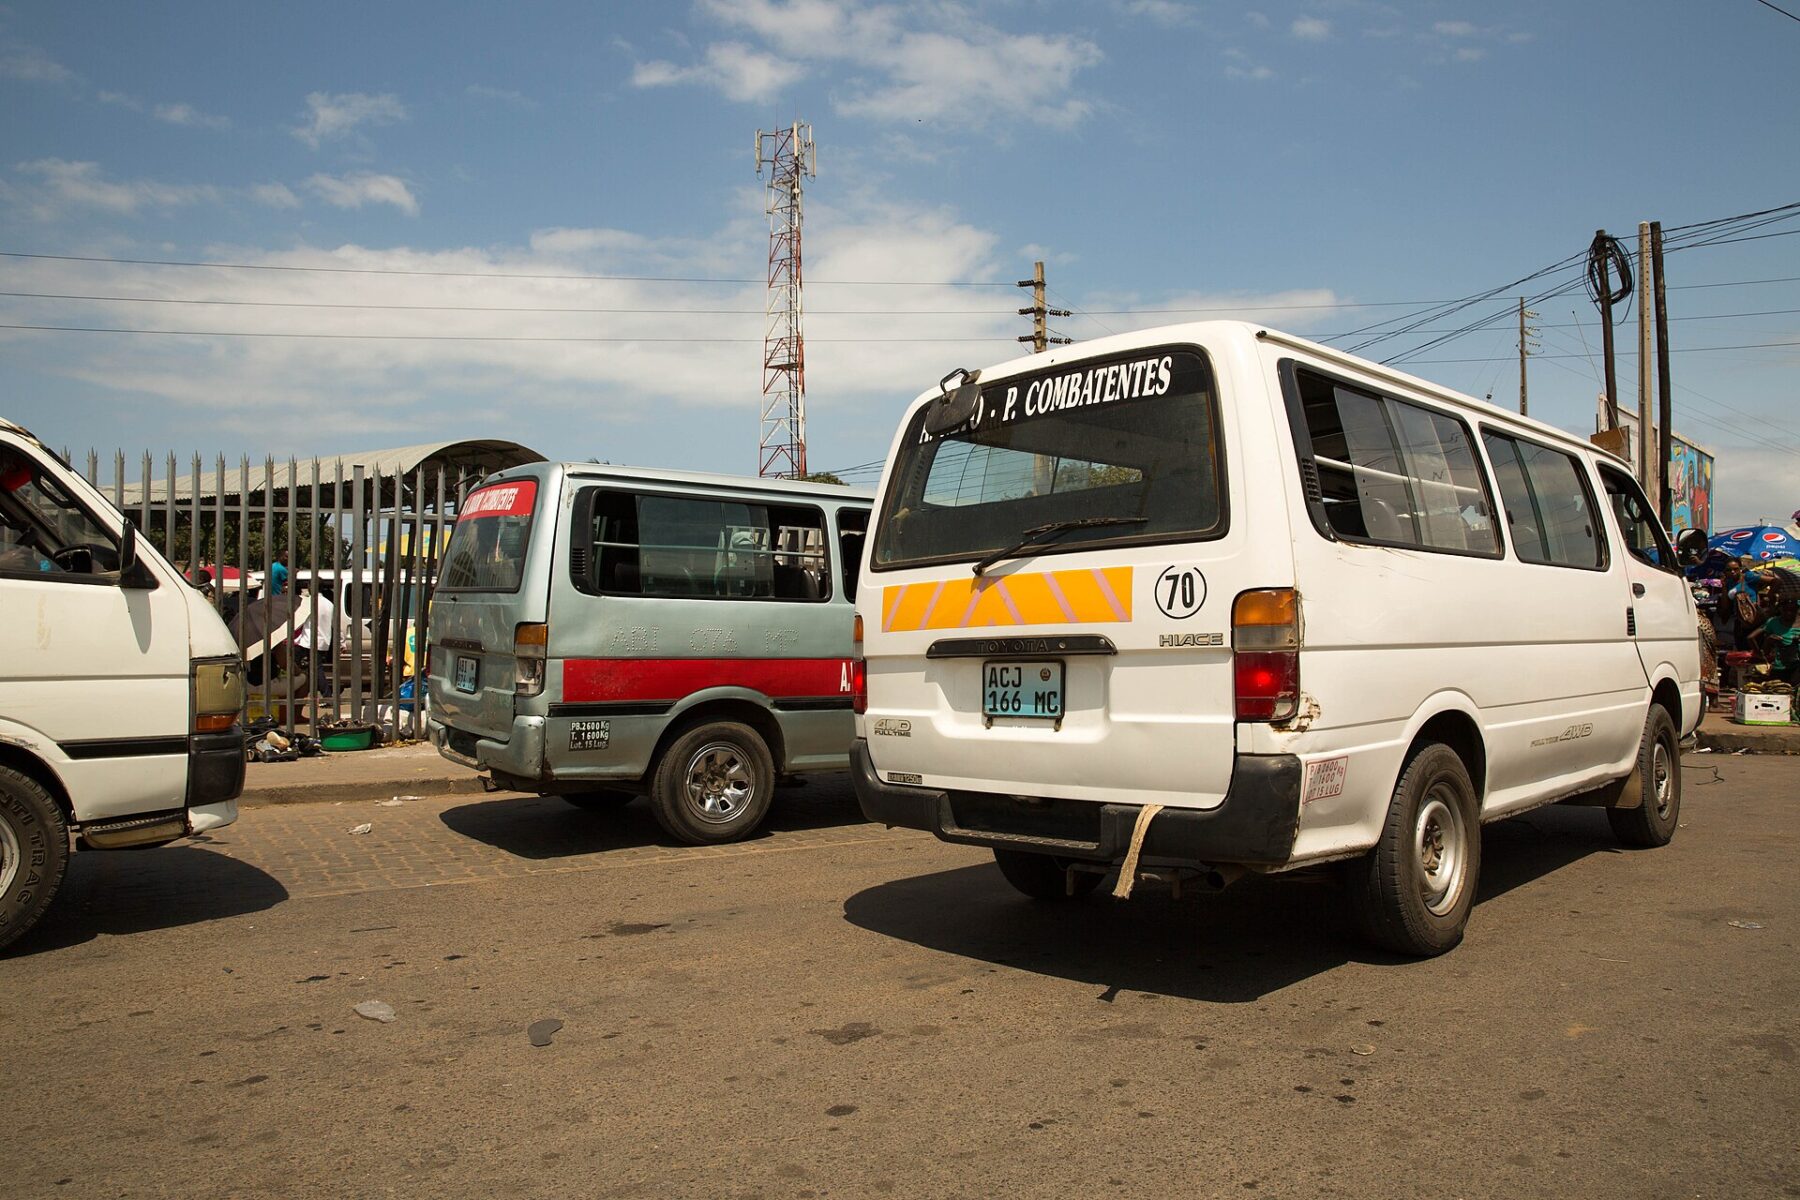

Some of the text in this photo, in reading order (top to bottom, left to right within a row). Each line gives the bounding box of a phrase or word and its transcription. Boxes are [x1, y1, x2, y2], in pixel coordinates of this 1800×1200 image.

[1002, 387, 1016, 421] P.
[1024, 356, 1173, 416] COMBATENTES
[1165, 572, 1194, 610] 70
[610, 626, 799, 652] ABI 076 MP
[976, 640, 1048, 653] TOYOTA
[1159, 633, 1223, 647] HIACE
[988, 667, 1022, 688] ACJ
[988, 691, 1058, 714] 166 MC
[1559, 723, 1594, 741] 4WD
